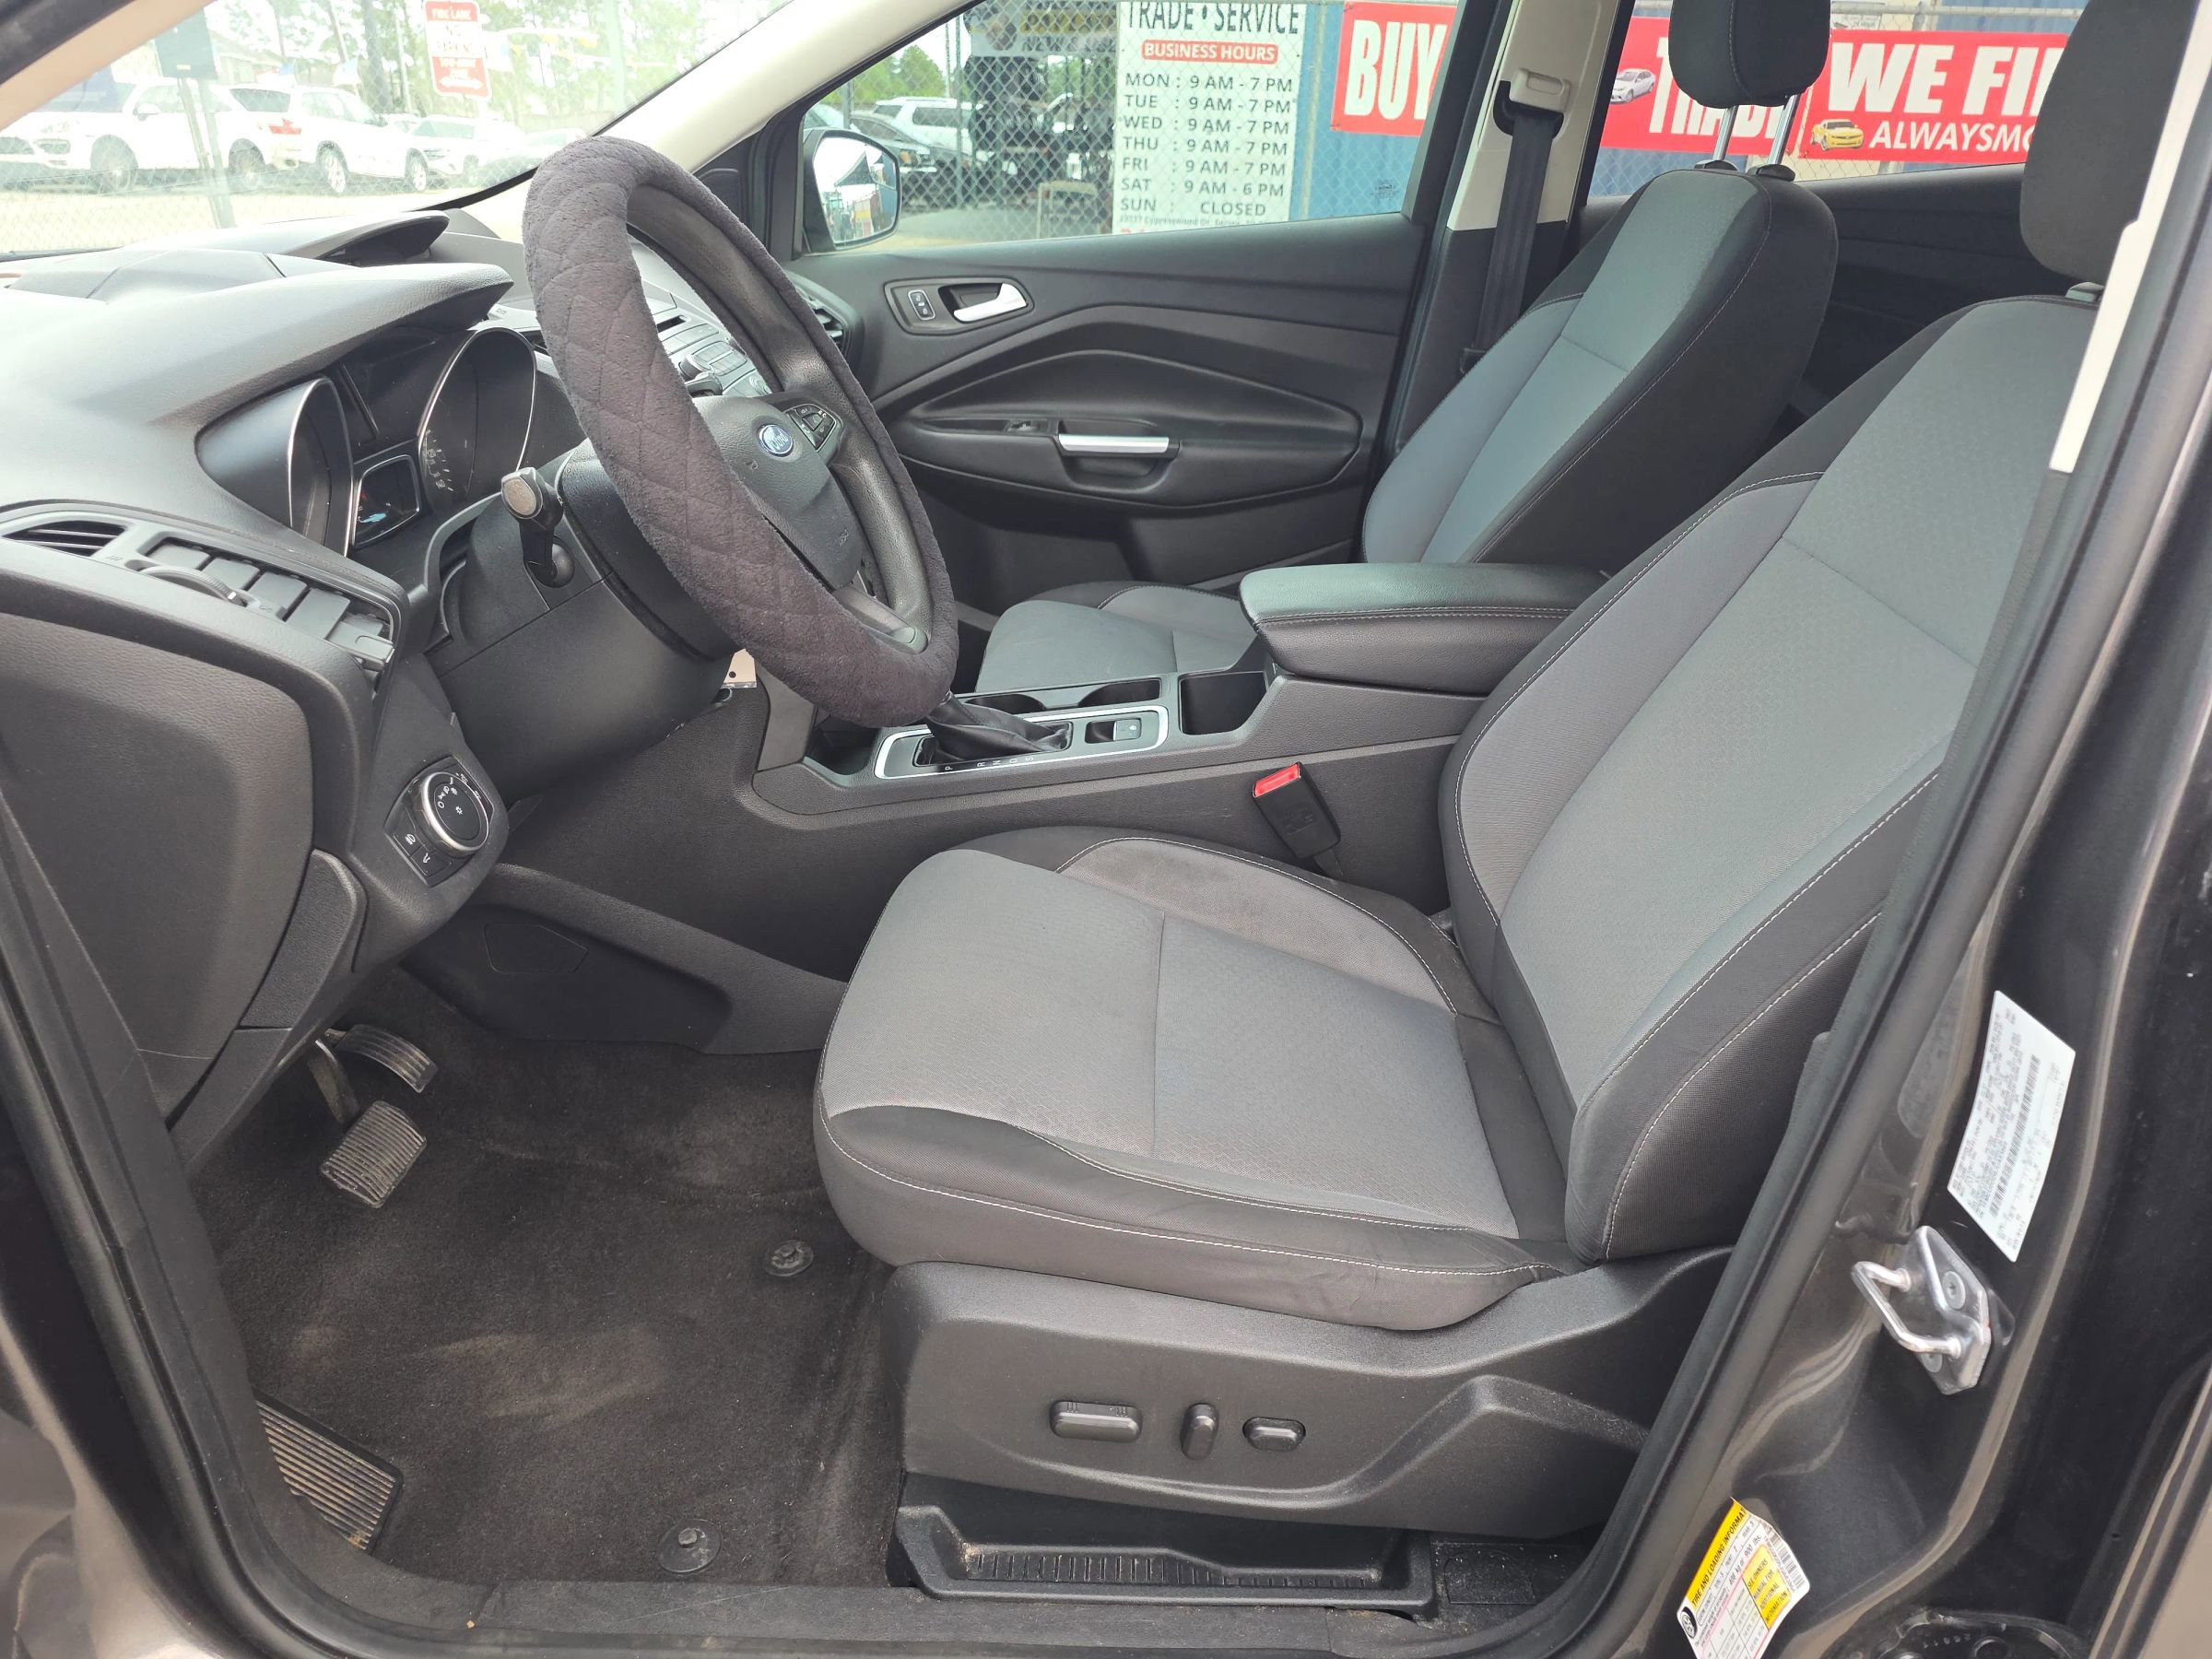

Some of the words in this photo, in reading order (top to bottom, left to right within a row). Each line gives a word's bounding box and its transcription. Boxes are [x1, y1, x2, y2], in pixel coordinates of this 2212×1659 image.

[1126, 2, 1194, 30] TRADE
[1214, 3, 1299, 34] SERVICE
[1145, 43, 1218, 58] BUSINESS
[1220, 46, 1276, 61] HOURS
[1344, 19, 1447, 120] BUY
[1828, 41, 1955, 114] WE
[1125, 73, 1170, 88] MON
[1190, 75, 1199, 88] 9
[1205, 76, 1233, 89] AM
[1251, 77, 1260, 90] 7
[1266, 78, 1292, 92] PM
[1124, 94, 1159, 108] TUE
[1189, 97, 1198, 110] 9
[1204, 98, 1232, 111] AM
[1249, 100, 1259, 112] 7
[1265, 100, 1290, 113] PM
[1124, 116, 1163, 129] WED
[1188, 118, 1197, 131] 9
[1203, 119, 1230, 132] AM
[1248, 121, 1256, 133] 7
[1263, 122, 1288, 135] PM
[1124, 136, 1159, 150] THU
[1187, 139, 1195, 152] 9
[1202, 140, 1229, 153] AM
[1246, 141, 1255, 155] 7
[1261, 142, 1287, 155] PM
[1123, 158, 1148, 171] FRI
[1185, 159, 1194, 172] 9
[1200, 160, 1228, 174] AM
[1245, 162, 1254, 175] 7
[1260, 163, 1286, 176] PM
[1121, 178, 1151, 191] SAT
[1184, 181, 1194, 194] 9
[1199, 182, 1226, 194] AM
[1242, 183, 1253, 195] 6
[1258, 183, 1284, 197] PM
[1120, 198, 1157, 212] SUN
[1200, 202, 1266, 216] CLOSED
[1691, 1588, 1701, 1607] TIRE
[1700, 1573, 1710, 1591] AND
[1707, 1545, 1724, 1576] LOADING
